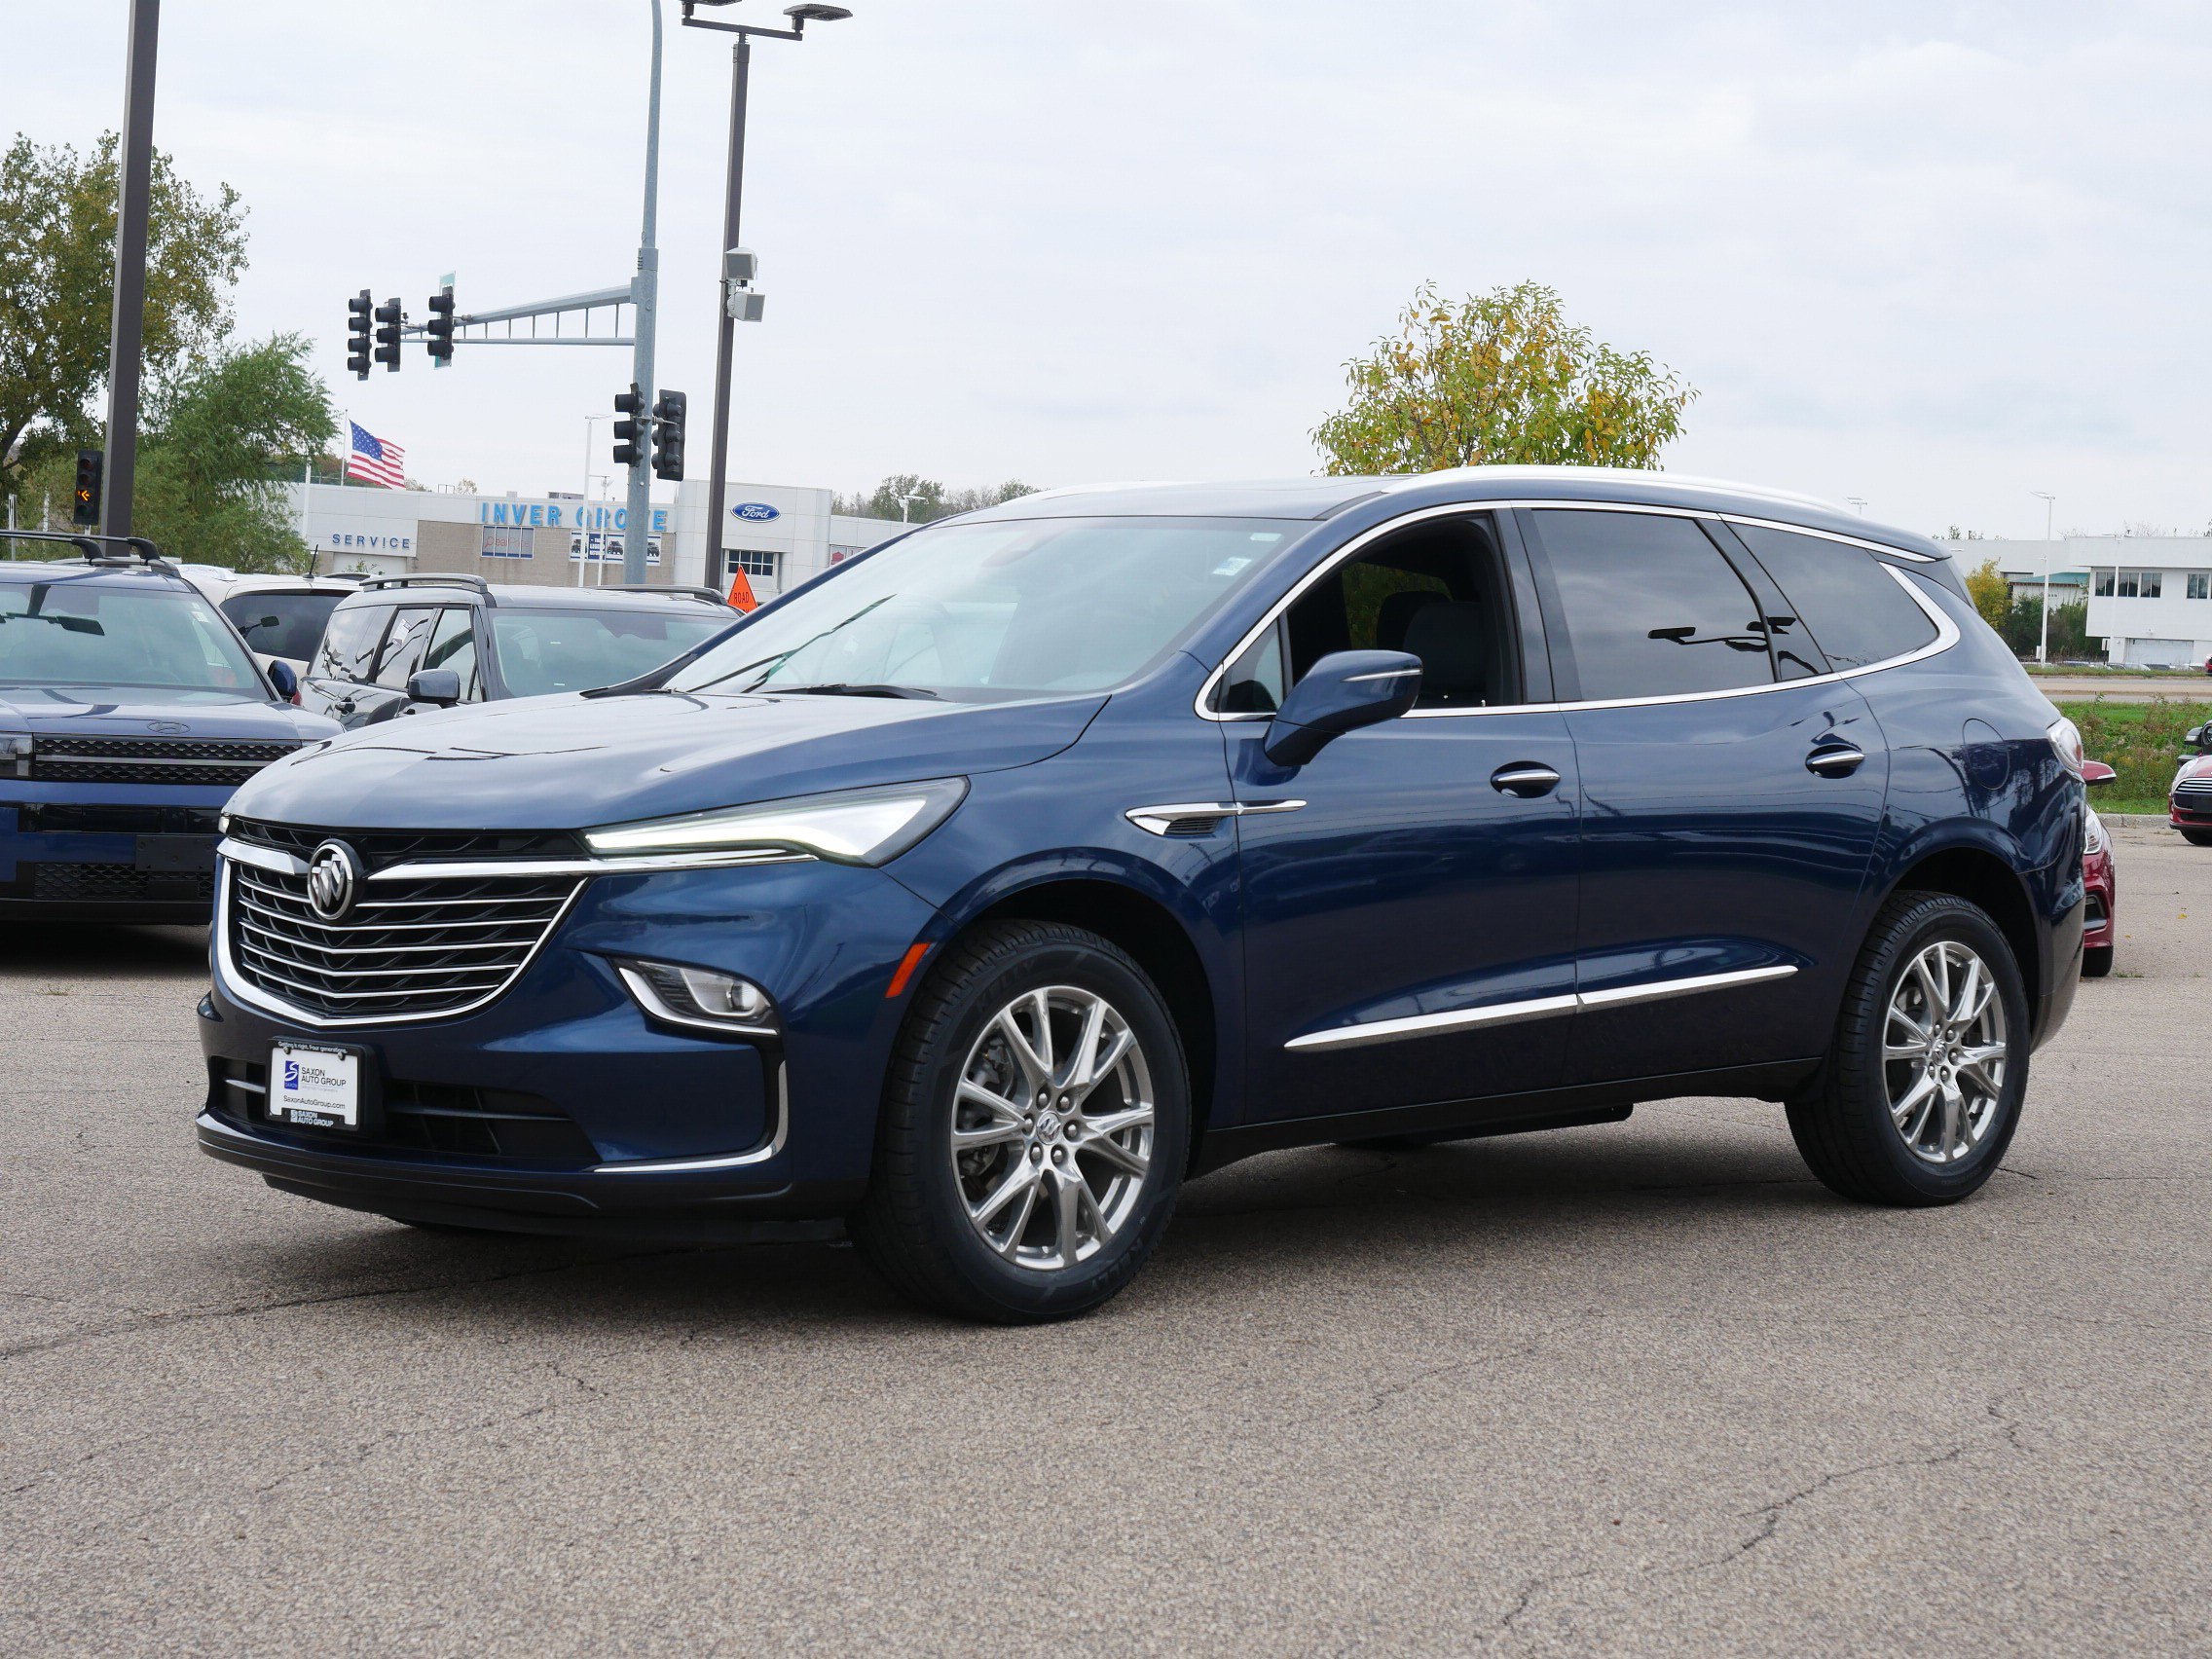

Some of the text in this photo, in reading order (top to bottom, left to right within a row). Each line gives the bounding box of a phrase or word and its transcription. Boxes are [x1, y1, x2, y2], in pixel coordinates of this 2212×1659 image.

[482, 502, 667, 531] INVER GROE
[741, 505, 770, 518] Ford
[332, 534, 411, 549] SERVICE
[733, 592, 750, 604] ROAD
[302, 1067, 325, 1077] SAXON
[301, 1076, 347, 1087] AUTO GROUP
[283, 1095, 346, 1109] SaxonAutoGroup.com
[313, 1118, 334, 1127] GROUP
